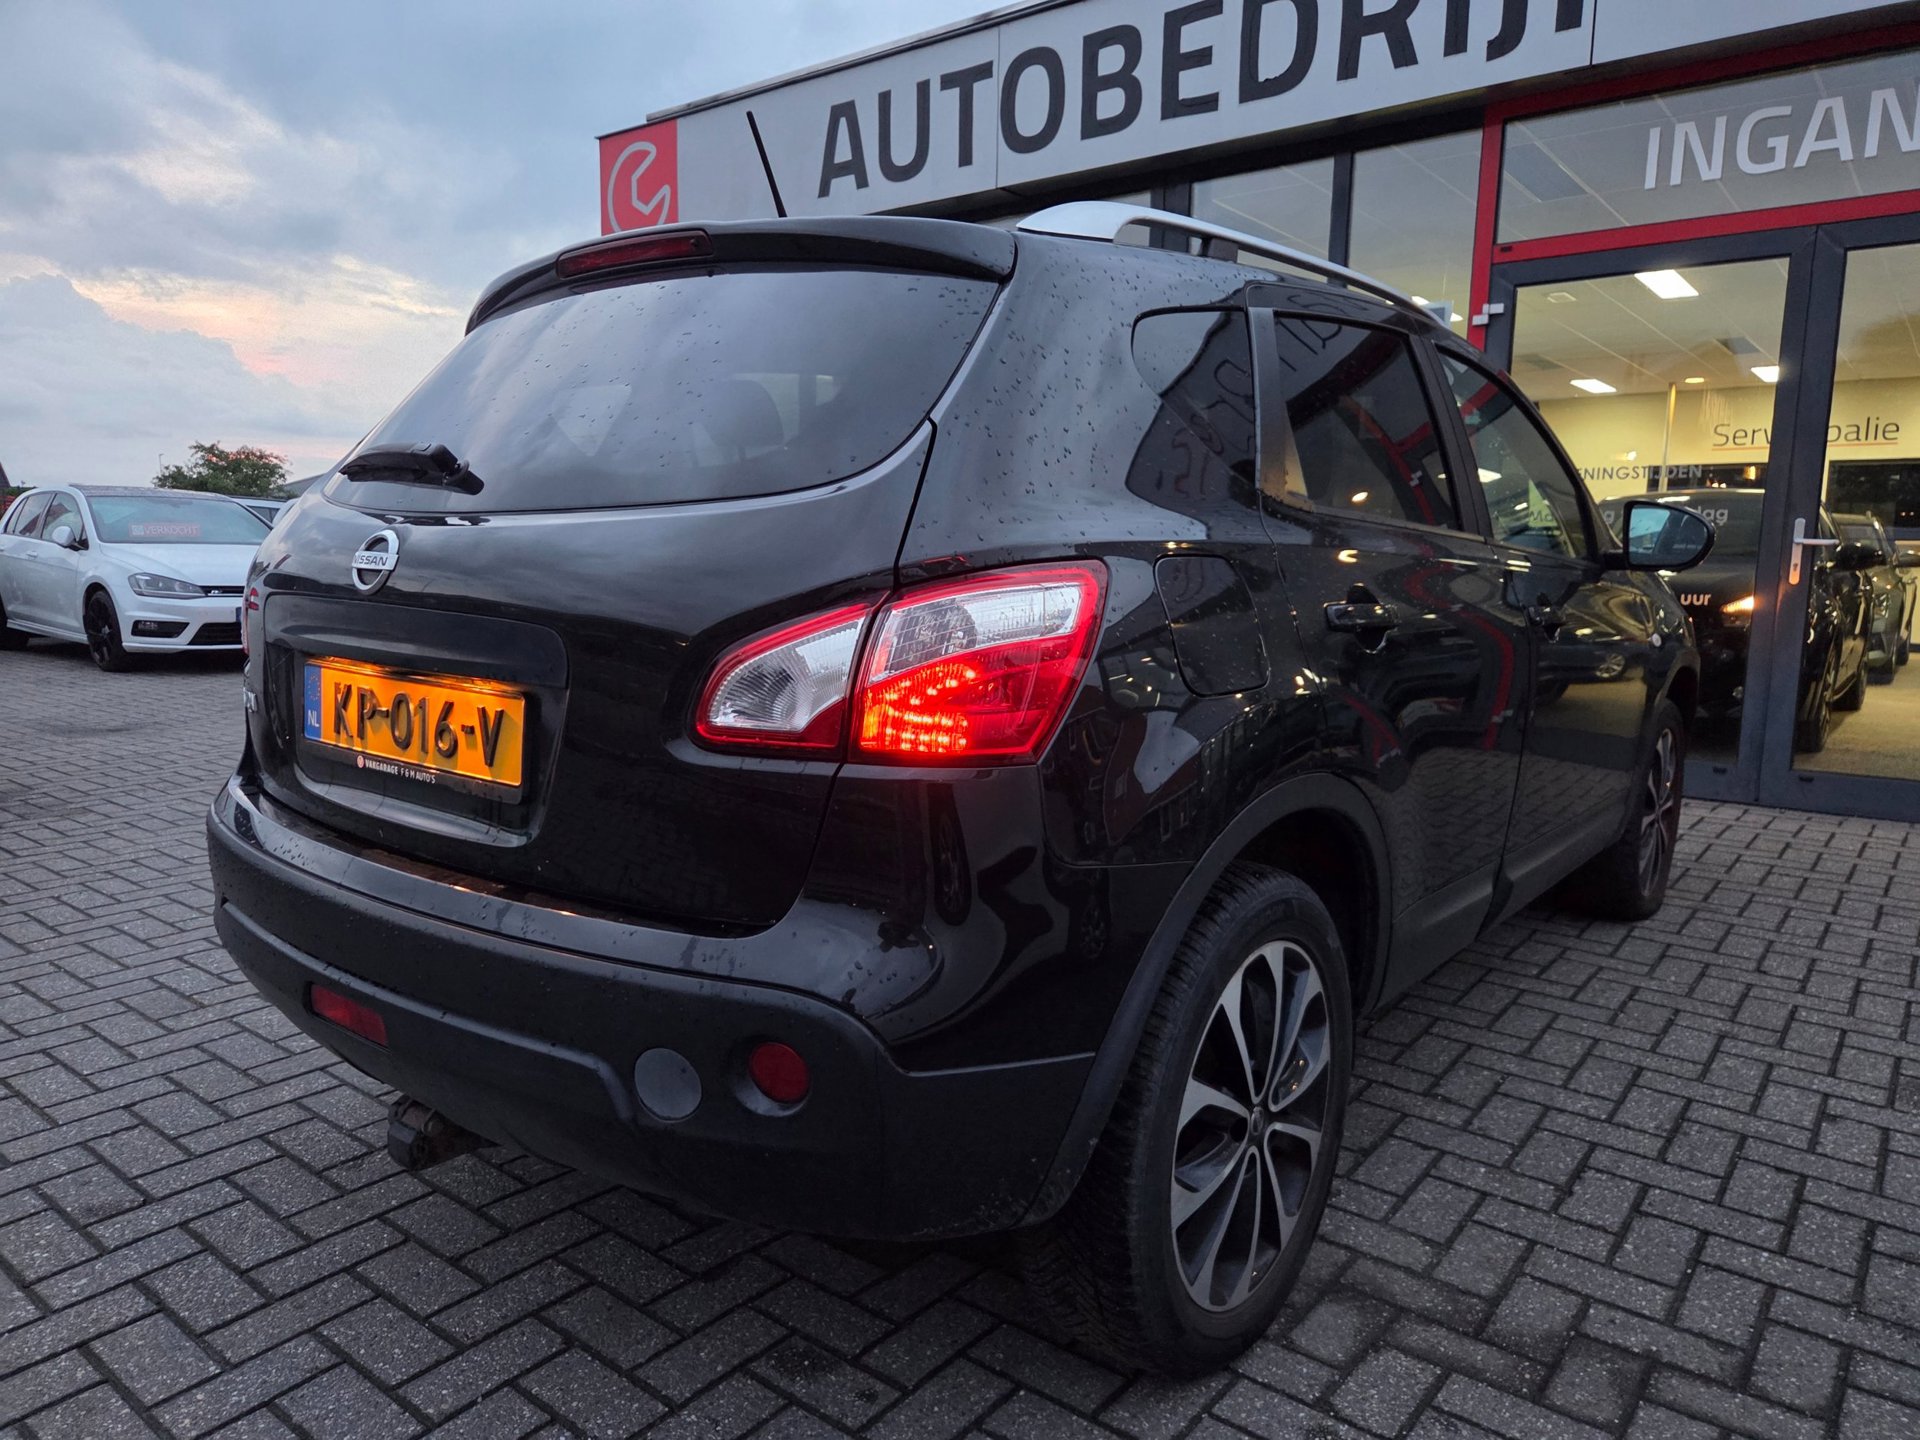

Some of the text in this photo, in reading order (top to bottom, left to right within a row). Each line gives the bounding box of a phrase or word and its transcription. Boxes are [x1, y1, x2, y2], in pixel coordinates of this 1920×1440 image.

[1680, 592, 1712, 606] uur
[307, 709, 320, 728] NL
[334, 682, 504, 767] KP-016-V
[365, 759, 399, 775] VAKGARAGE
